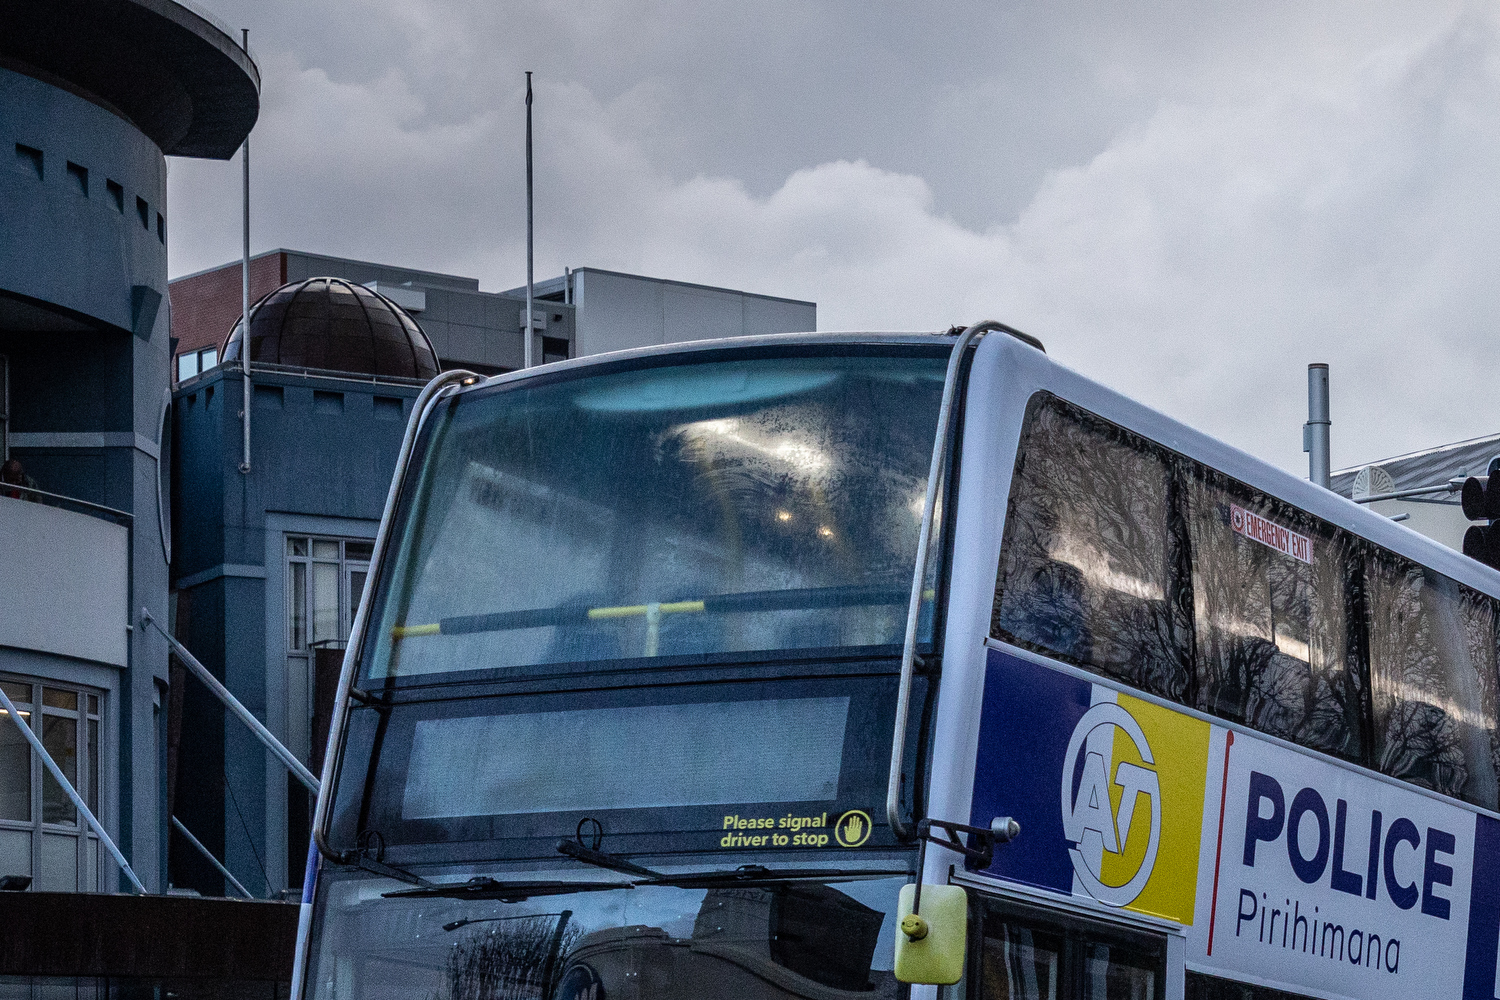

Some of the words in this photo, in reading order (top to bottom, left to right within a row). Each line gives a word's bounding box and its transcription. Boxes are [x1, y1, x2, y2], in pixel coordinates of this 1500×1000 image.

[1245, 513, 1290, 553] EMERGENCY
[1291, 533, 1308, 561] EXIT
[720, 832, 769, 847] driver
[772, 833, 789, 846] to
[792, 833, 829, 848] stop
[722, 815, 774, 830] Please
[778, 812, 827, 832] signal
[1242, 770, 1456, 921] POLICE
[1236, 888, 1401, 974] Pirihimana
